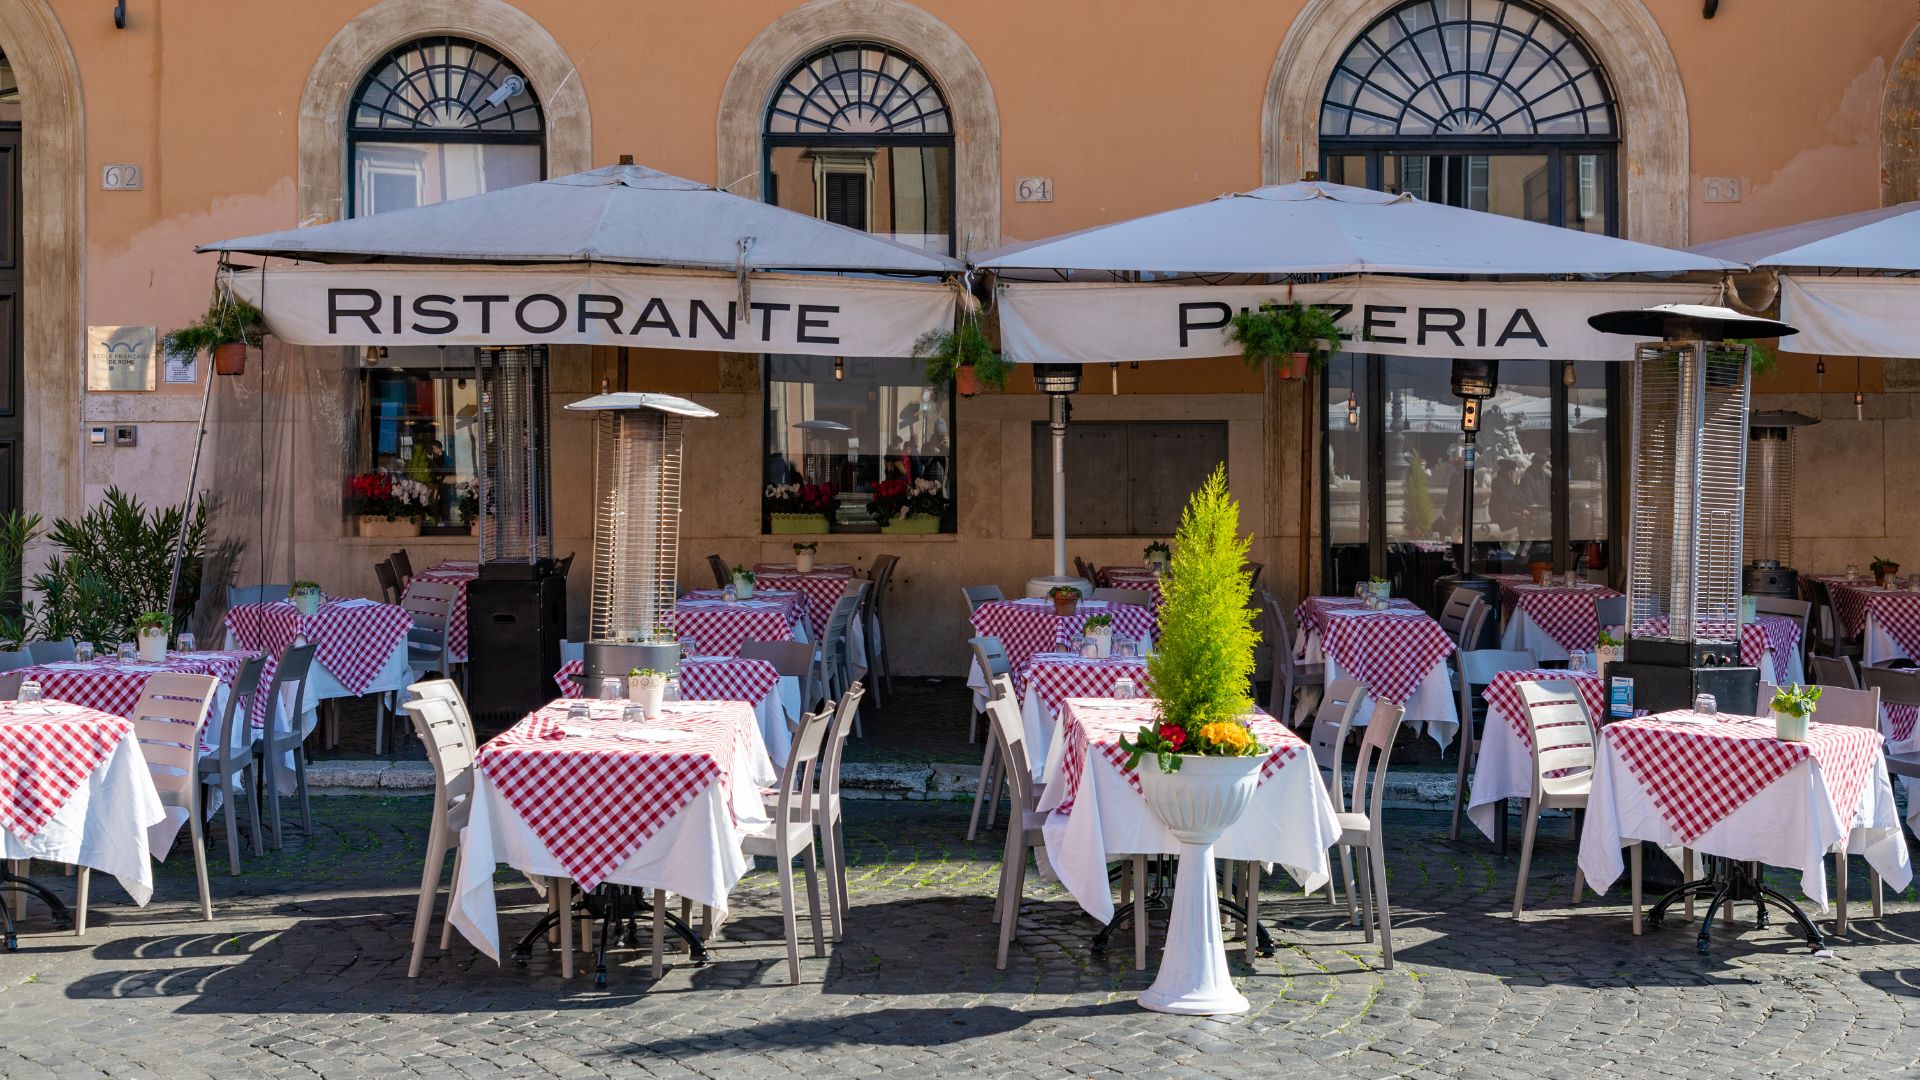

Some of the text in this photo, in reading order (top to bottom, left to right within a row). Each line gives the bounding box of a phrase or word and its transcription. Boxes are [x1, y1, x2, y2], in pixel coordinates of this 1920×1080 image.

[106, 166, 137, 187] 62
[1019, 179, 1049, 199] 64
[326, 288, 841, 345] RISTORANTE
